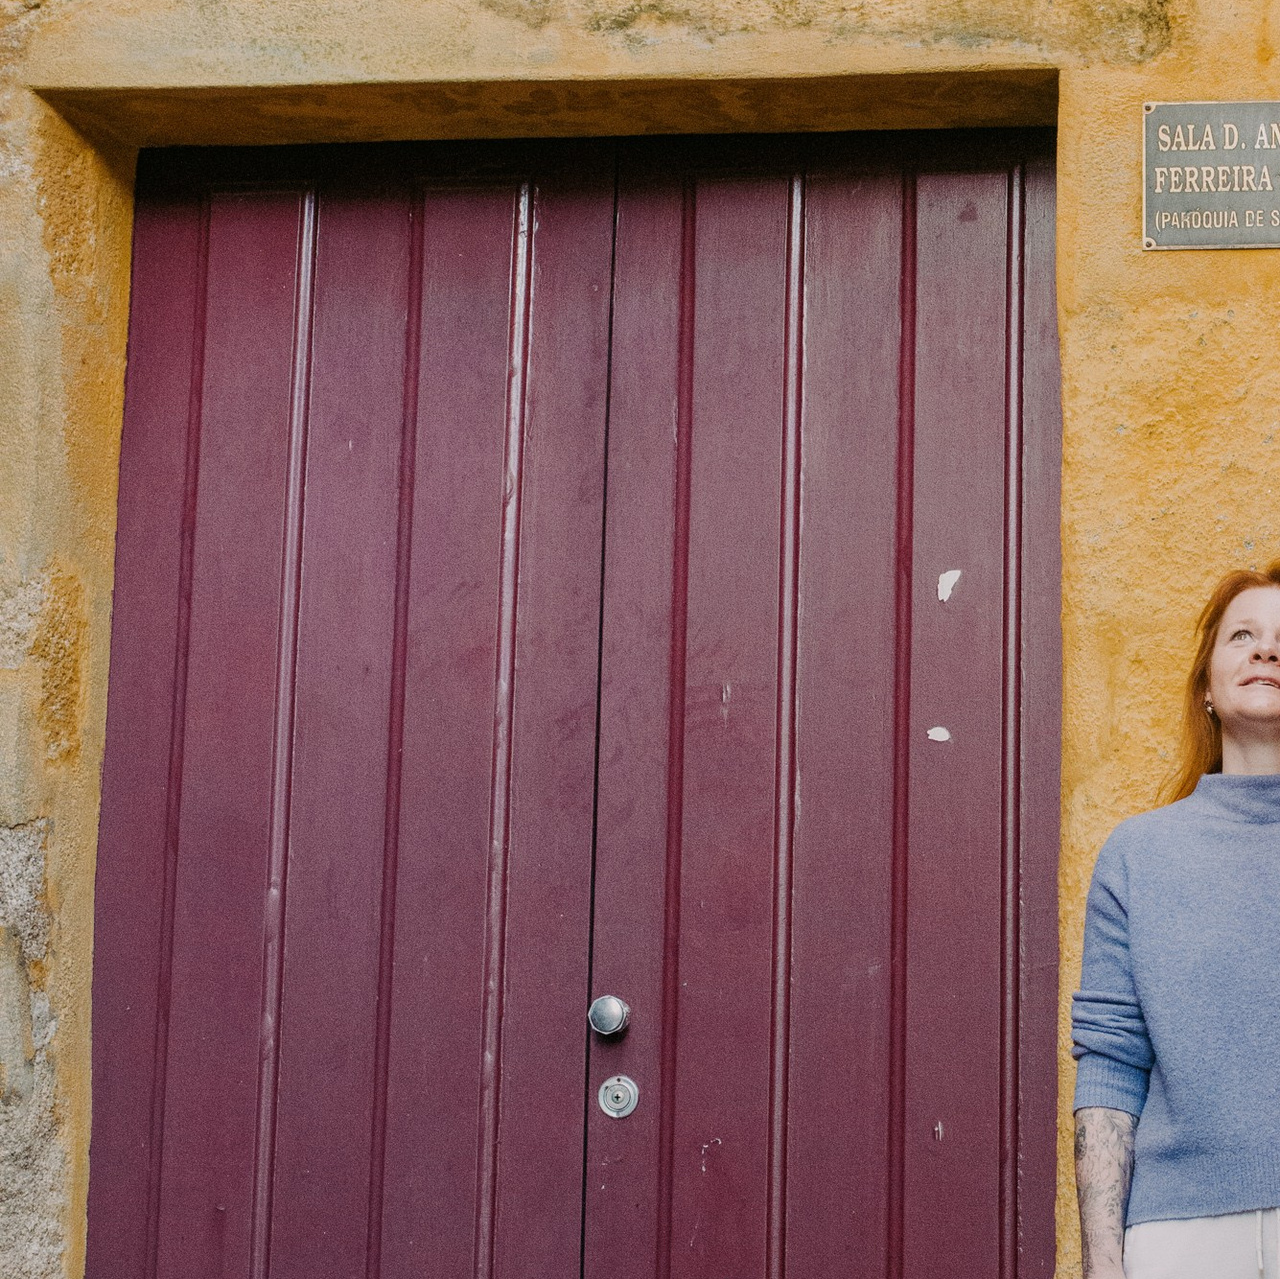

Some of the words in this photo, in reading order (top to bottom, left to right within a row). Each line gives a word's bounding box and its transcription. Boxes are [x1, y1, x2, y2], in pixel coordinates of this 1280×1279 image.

[1158, 124, 1216, 152] SALA
[1223, 123, 1247, 150] D.
[1154, 165, 1273, 193] FERREIRA
[1155, 208, 1239, 231] (PARÓQUIA
[1245, 210, 1264, 227] DE
